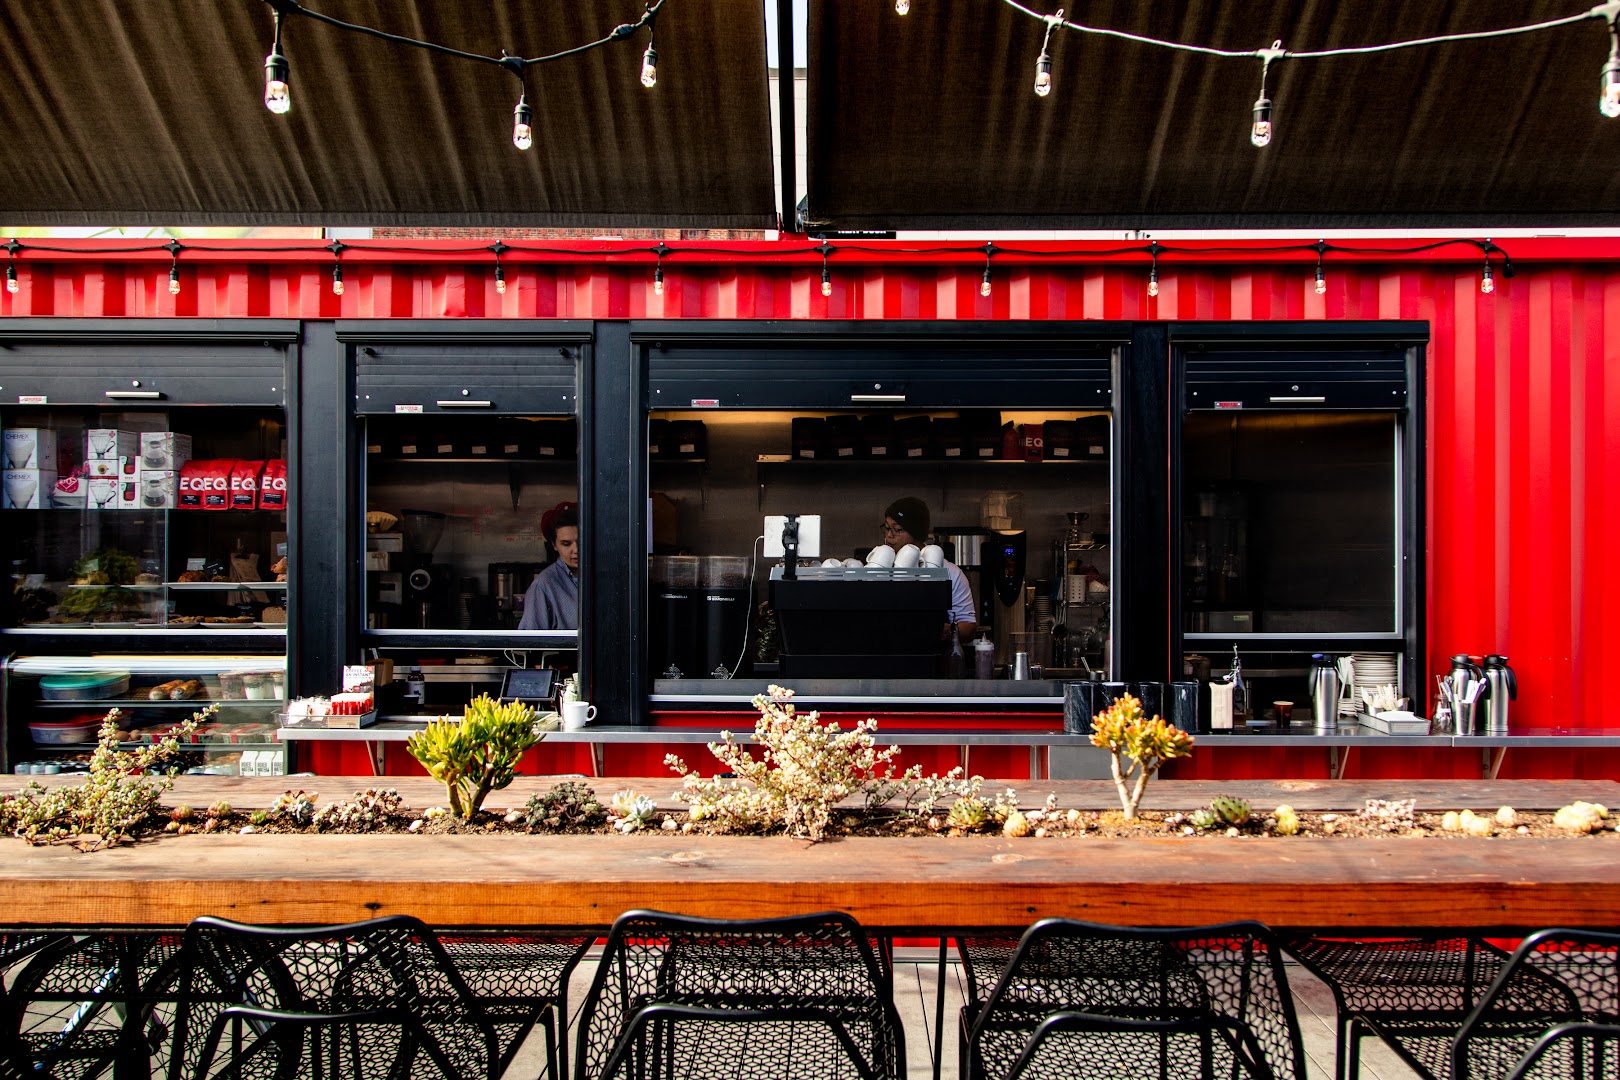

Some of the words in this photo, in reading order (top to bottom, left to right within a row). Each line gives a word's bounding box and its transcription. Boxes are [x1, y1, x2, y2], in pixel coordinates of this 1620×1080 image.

[1025, 437, 1044, 447] EQ
[179, 477, 205, 491] EQ
[204, 477, 228, 491] EQ
[231, 477, 256, 491] EQ
[261, 476, 287, 491] EQ
